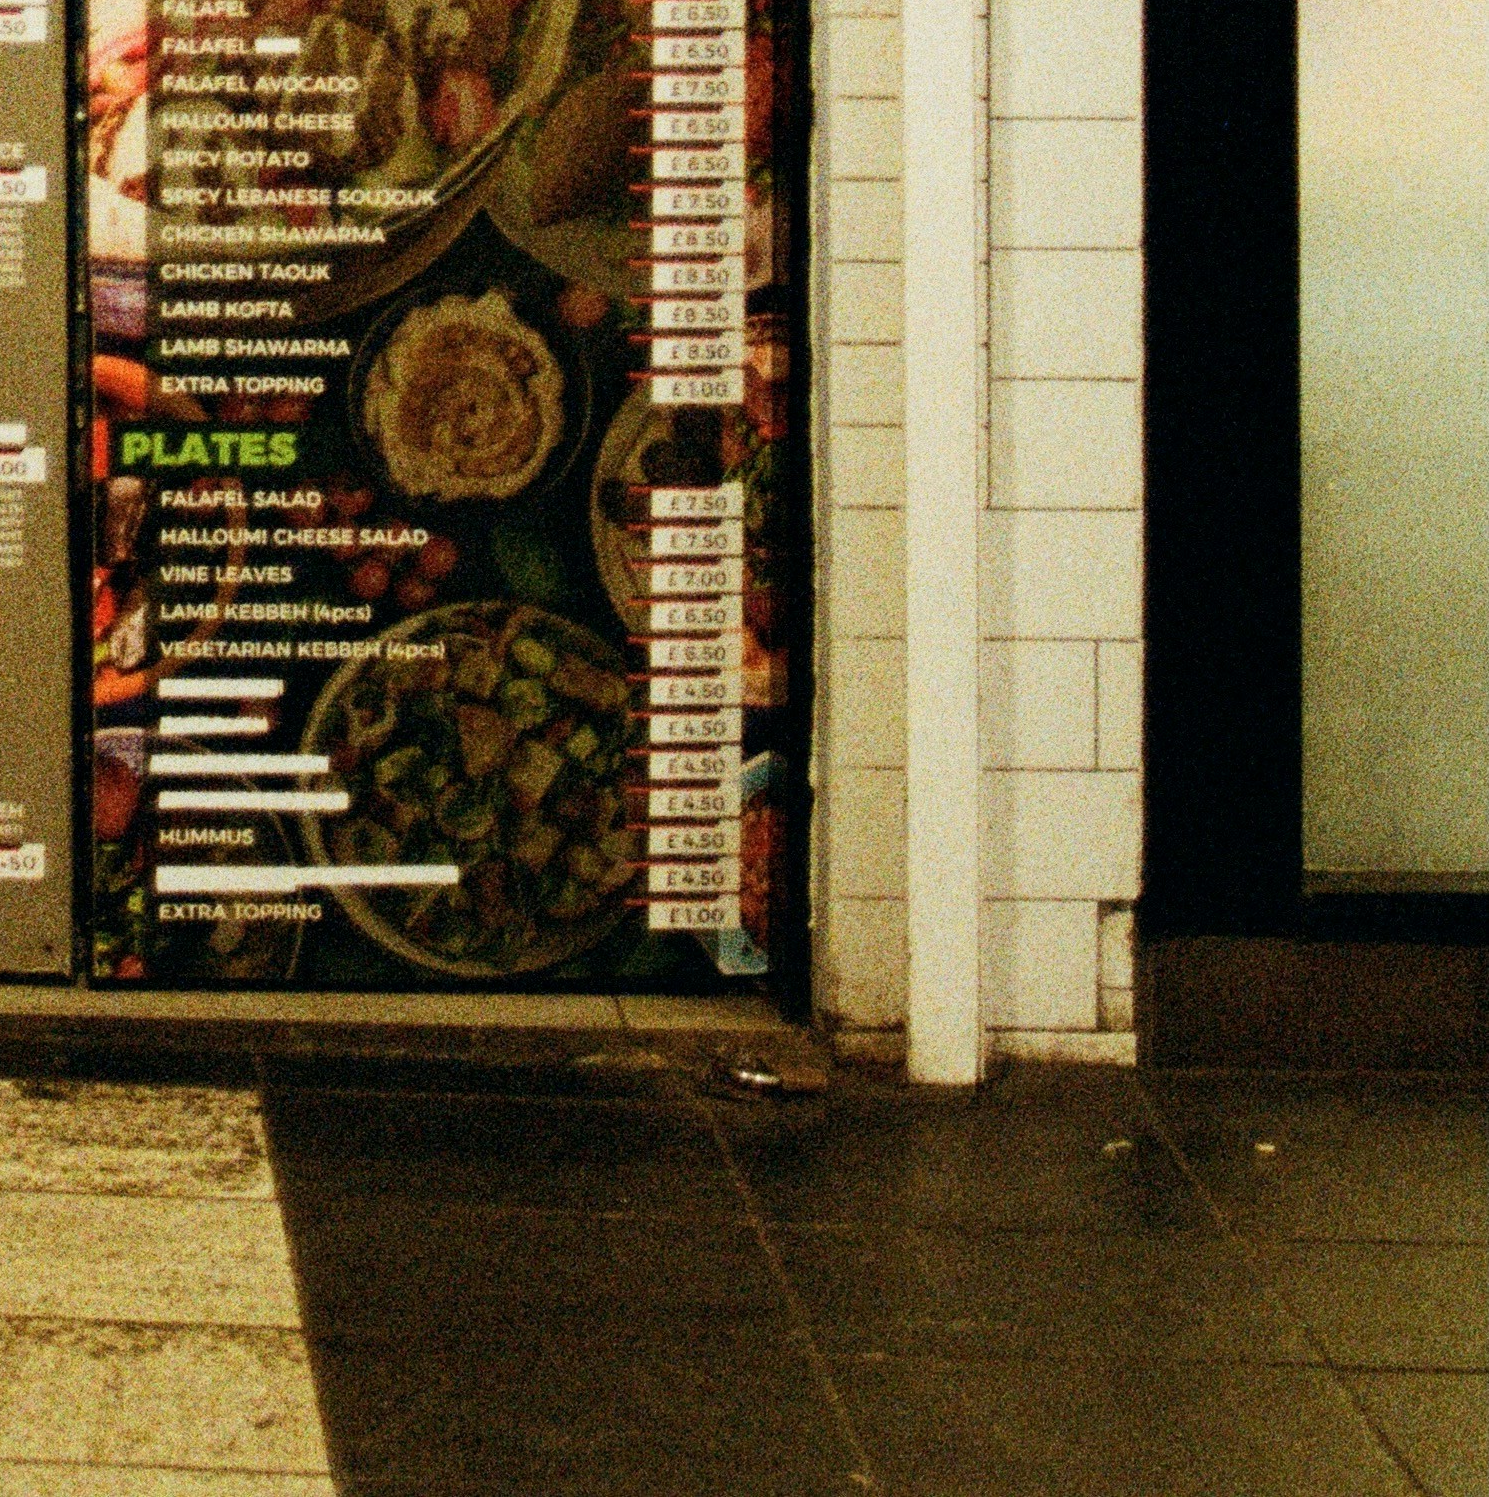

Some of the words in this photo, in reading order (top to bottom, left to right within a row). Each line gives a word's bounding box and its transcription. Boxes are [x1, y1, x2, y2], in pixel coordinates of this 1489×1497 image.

[161, 0, 250, 19] FALAFEL
[161, 37, 250, 56] FALAFEL
[161, 74, 250, 94] FALAFEL
[255, 75, 360, 94] AVOCADO
[161, 113, 268, 132] HALLOUMI
[274, 113, 356, 132] CHEESE
[161, 150, 222, 168] SPICY
[225, 150, 311, 169] POTATO
[160, 188, 221, 206] SPICY
[225, 188, 332, 207] LEBANESE
[337, 188, 438, 208] SOUJOUK
[160, 226, 254, 245] CHICKEN
[258, 226, 386, 245] SHAWARMA
[160, 263, 254, 282] CHICKEN
[257, 263, 331, 282] TAOUK
[160, 300, 220, 320] LAMB
[224, 301, 294, 320] KOFTA
[160, 338, 220, 358] LAMB
[223, 339, 351, 357] SHAWARMA
[160, 376, 229, 395] EXTRA
[234, 376, 325, 396] TOPPING
[122, 431, 298, 467] PLATES
[160, 489, 248, 508] FALAFEL
[252, 489, 323, 508] SALAD
[160, 527, 268, 546] HALLOUMI
[273, 527, 355, 546] CHEESE
[359, 527, 429, 547] SALAD
[160, 565, 210, 584] VINE
[214, 565, 294, 584] LEAVES
[159, 603, 219, 621] LAMB
[224, 603, 308, 621] KEBBEH
[159, 641, 291, 659] VEGETARIAN
[297, 641, 381, 659] KEBBEH
[159, 829, 255, 846] HUMMUS
[159, 903, 227, 921] EXTRA
[233, 903, 323, 921] TOPPING
